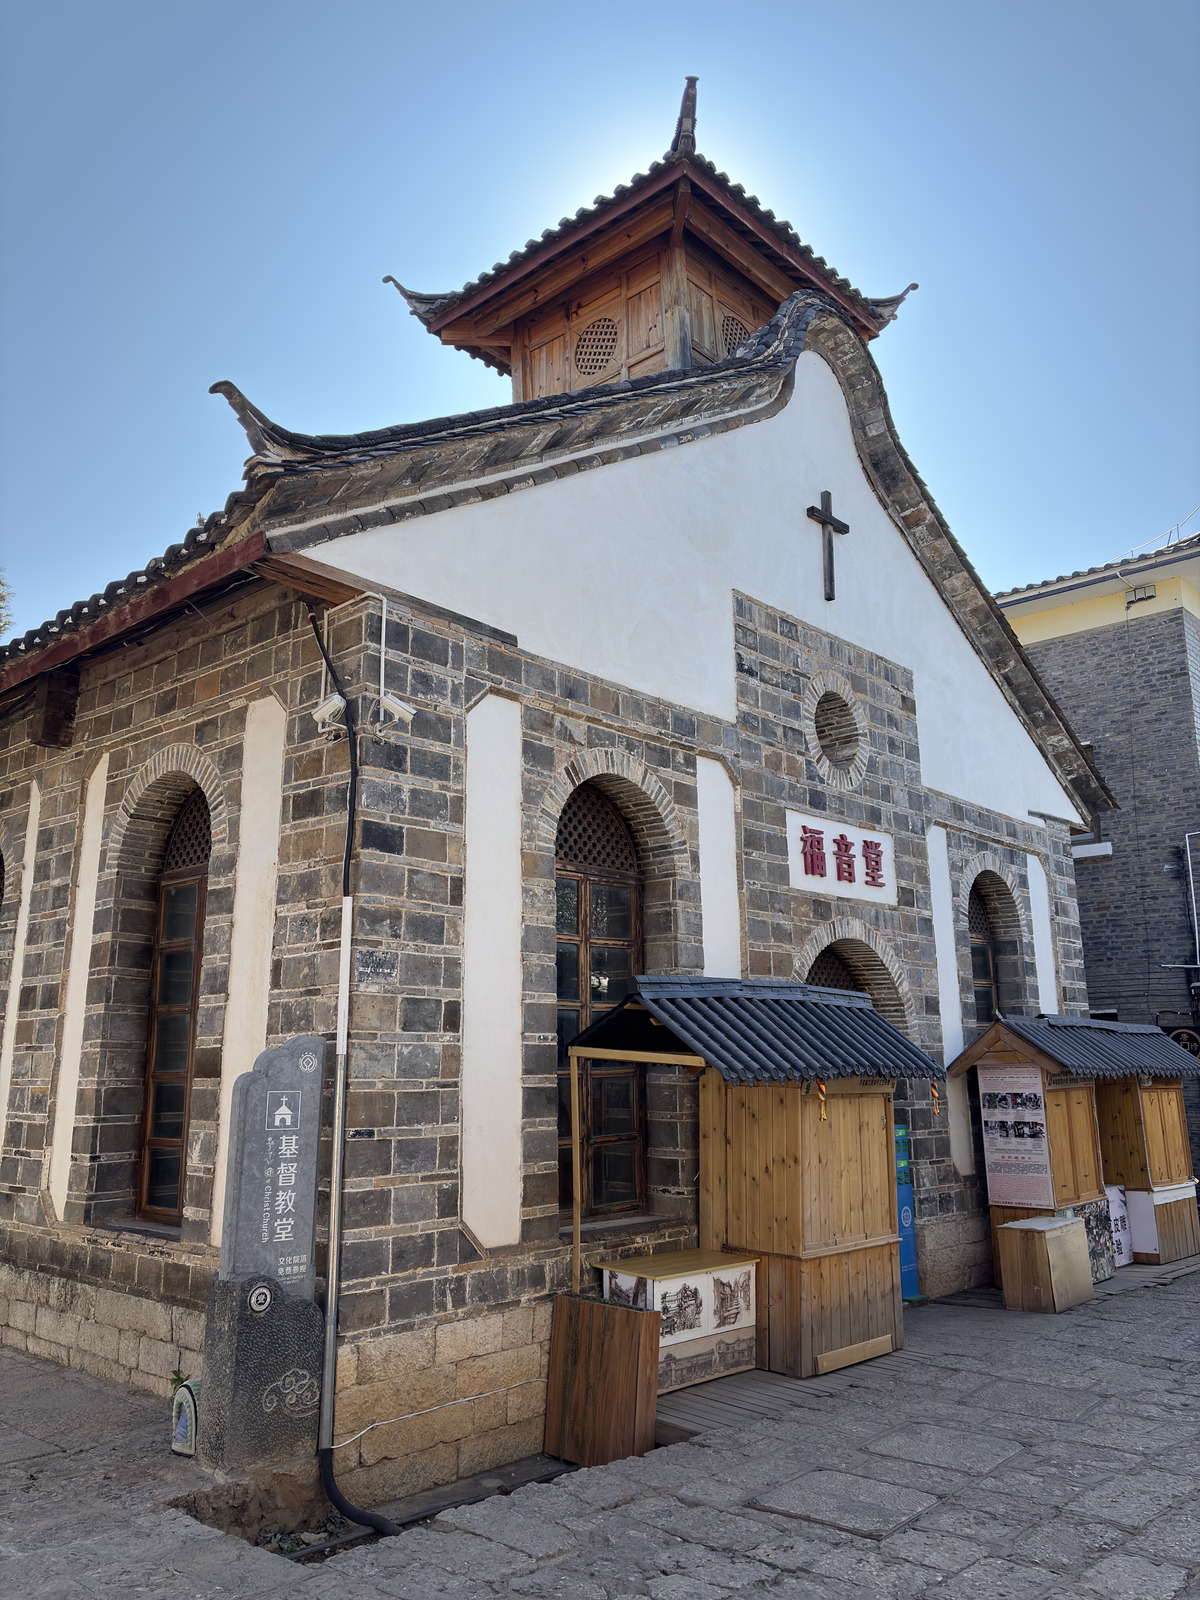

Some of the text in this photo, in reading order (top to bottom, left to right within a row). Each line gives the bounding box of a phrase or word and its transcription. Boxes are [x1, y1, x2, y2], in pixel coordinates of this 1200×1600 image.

[800, 825, 886, 887] 福音堂
[263, 1185, 272, 1211] Christ
[273, 1134, 299, 1242] 基督教堂
[261, 1212, 271, 1243] Church
[277, 1264, 307, 1276] 免费参观
[278, 1255, 307, 1266] 文化院落
